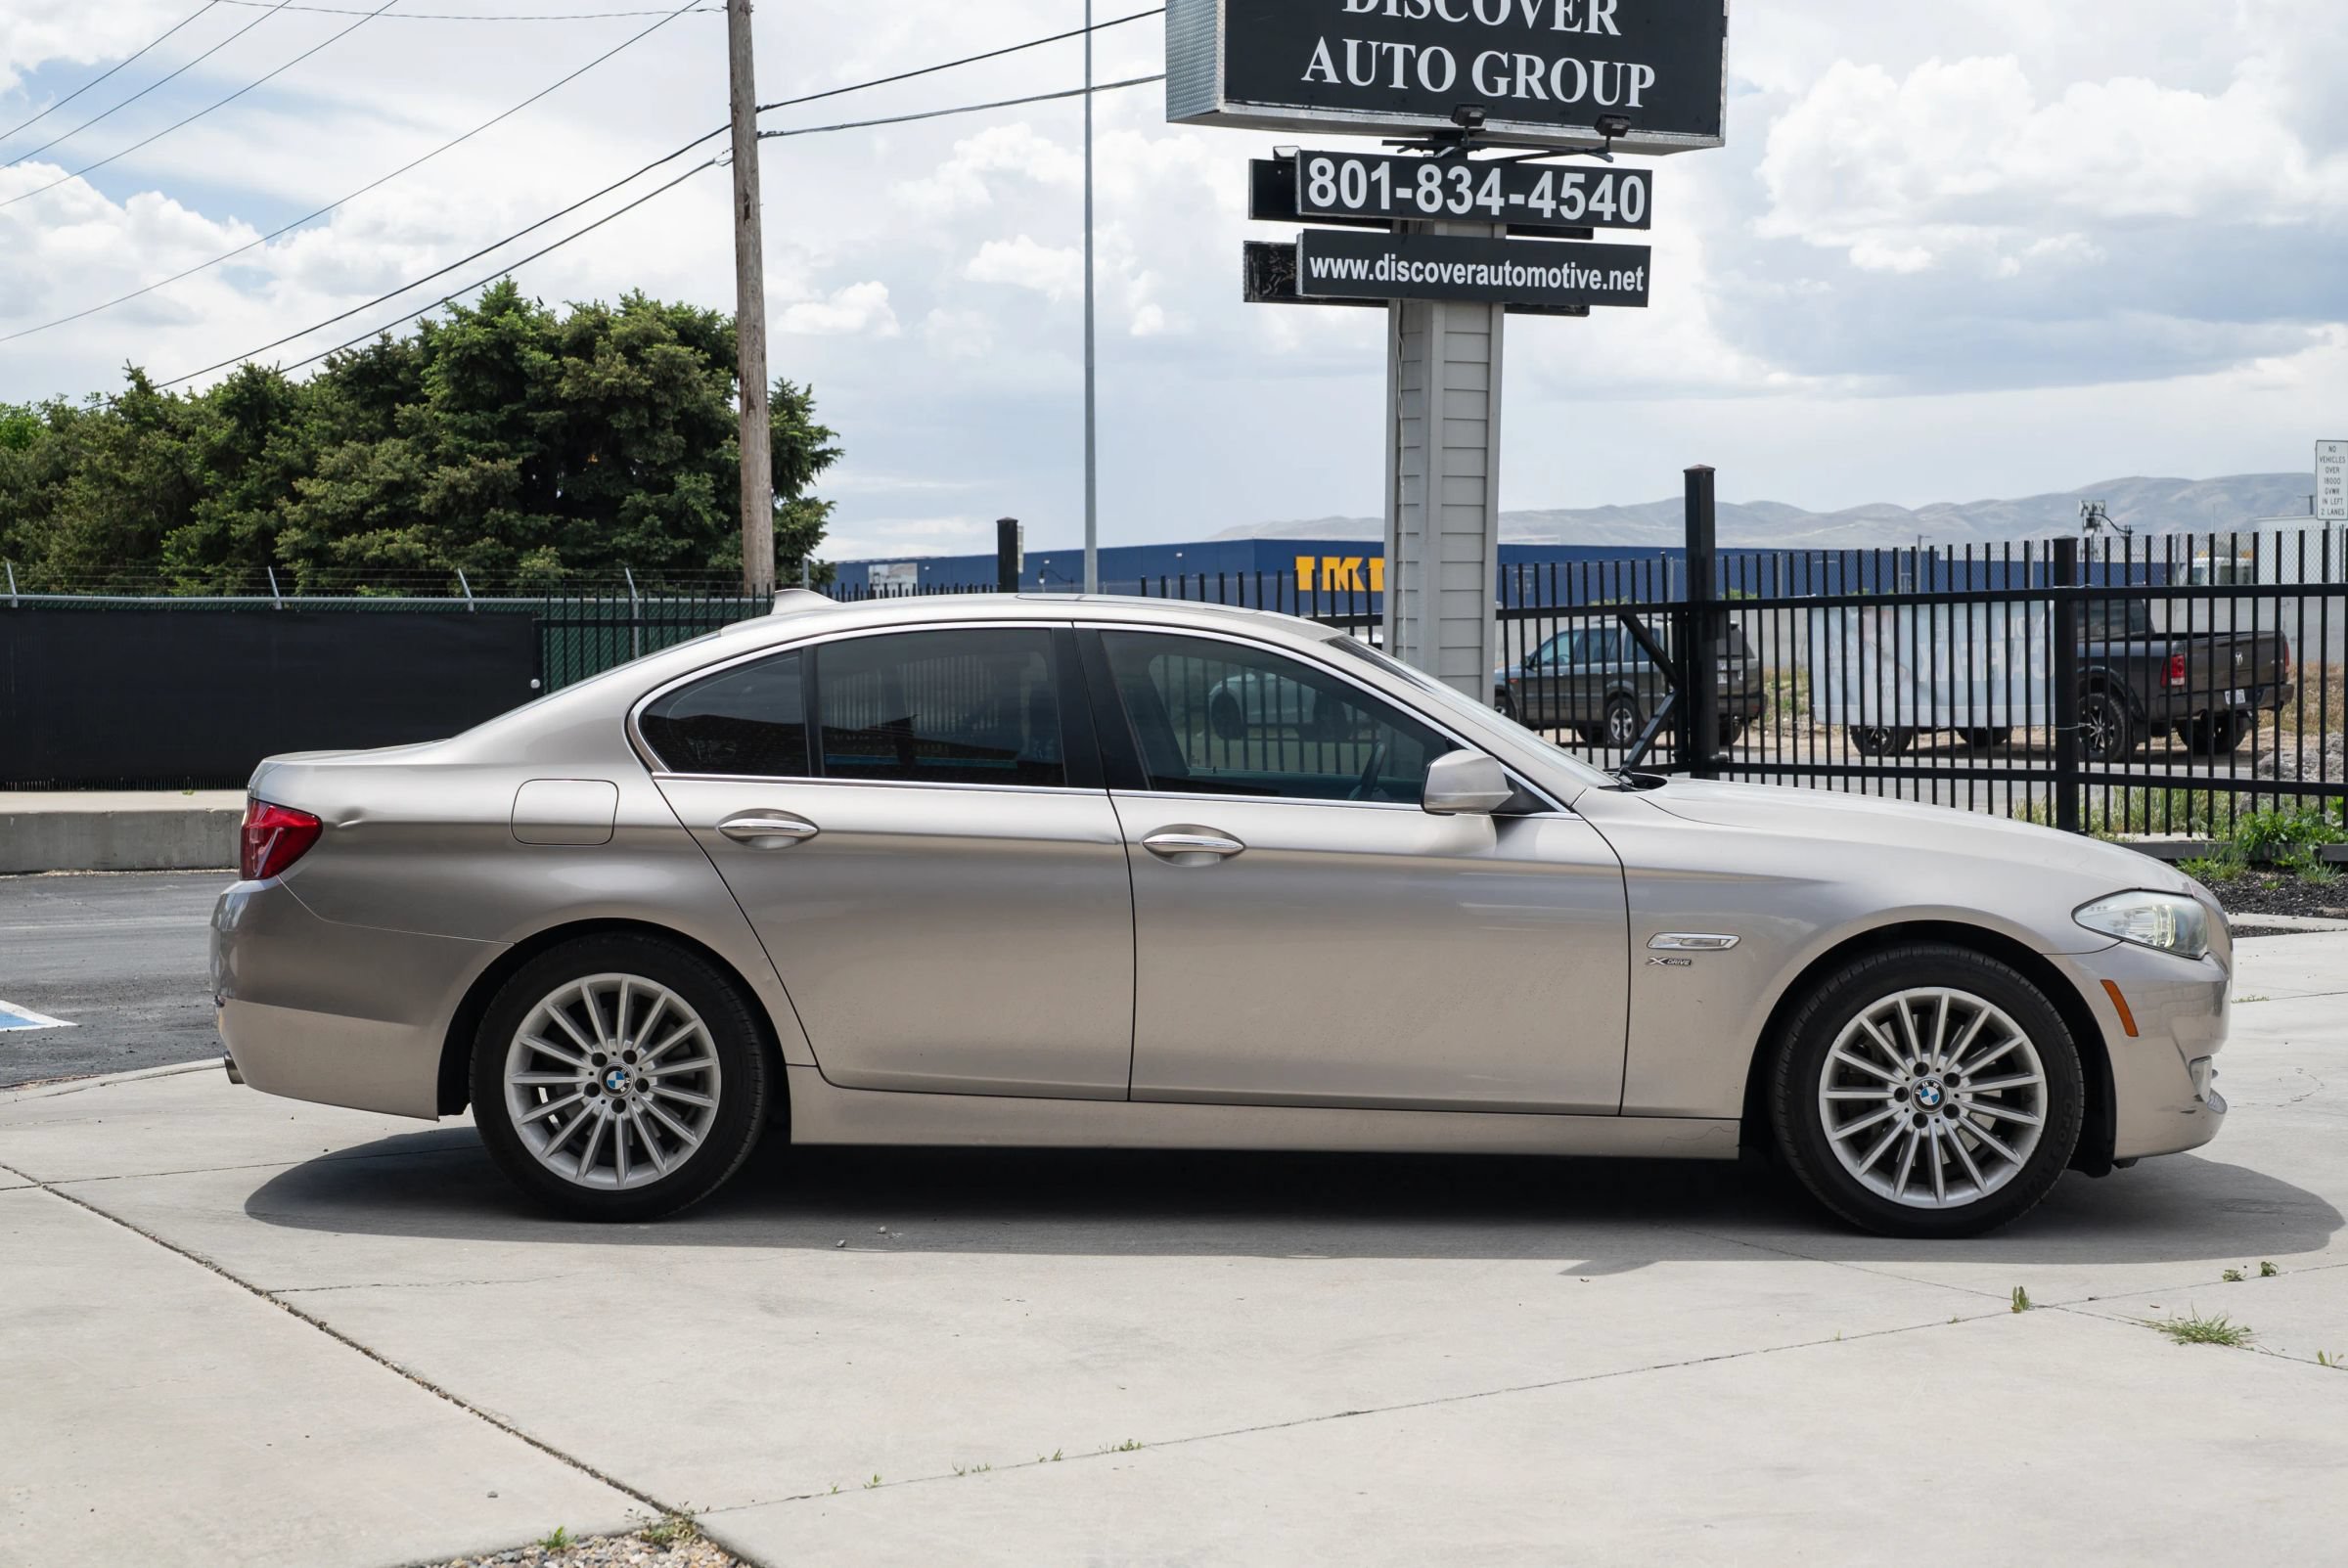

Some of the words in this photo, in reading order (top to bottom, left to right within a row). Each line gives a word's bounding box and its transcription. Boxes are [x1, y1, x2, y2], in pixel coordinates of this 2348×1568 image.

[1341, 0, 1622, 36] COVER
[1300, 35, 1457, 93] AUTO
[1471, 50, 1655, 108] GROUP
[1307, 157, 1646, 224] 801-834-4540
[1309, 252, 1645, 291] www.discoverautomotive.net
[2319, 455, 2346, 464] VEHICLES
[2325, 466, 2340, 474] OVER
[2326, 508, 2345, 516] LANES
[2330, 497, 2343, 506] LEFT
